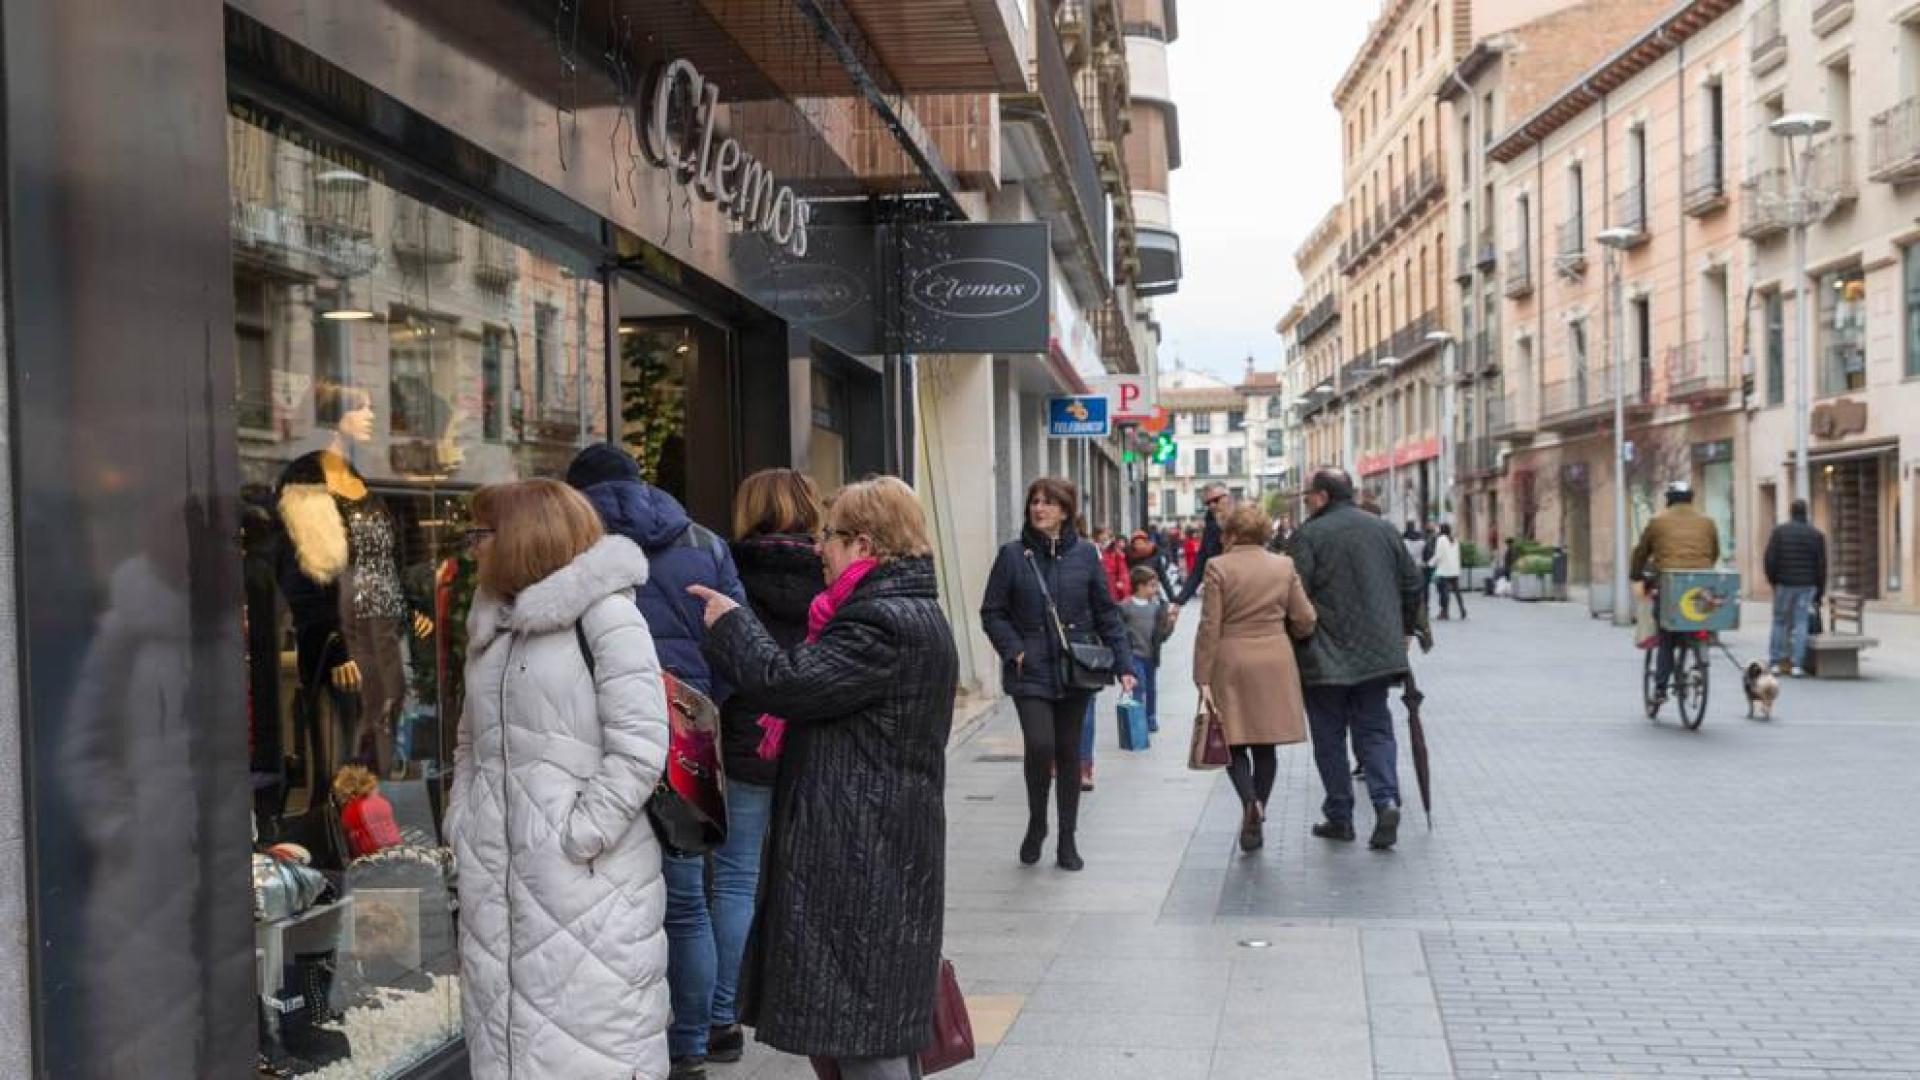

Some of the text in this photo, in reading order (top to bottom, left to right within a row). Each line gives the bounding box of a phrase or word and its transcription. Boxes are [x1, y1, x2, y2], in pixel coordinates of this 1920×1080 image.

[649, 58, 809, 256] Clemos
[926, 278, 1025, 299] Clemos
[1118, 384, 1140, 411] P
